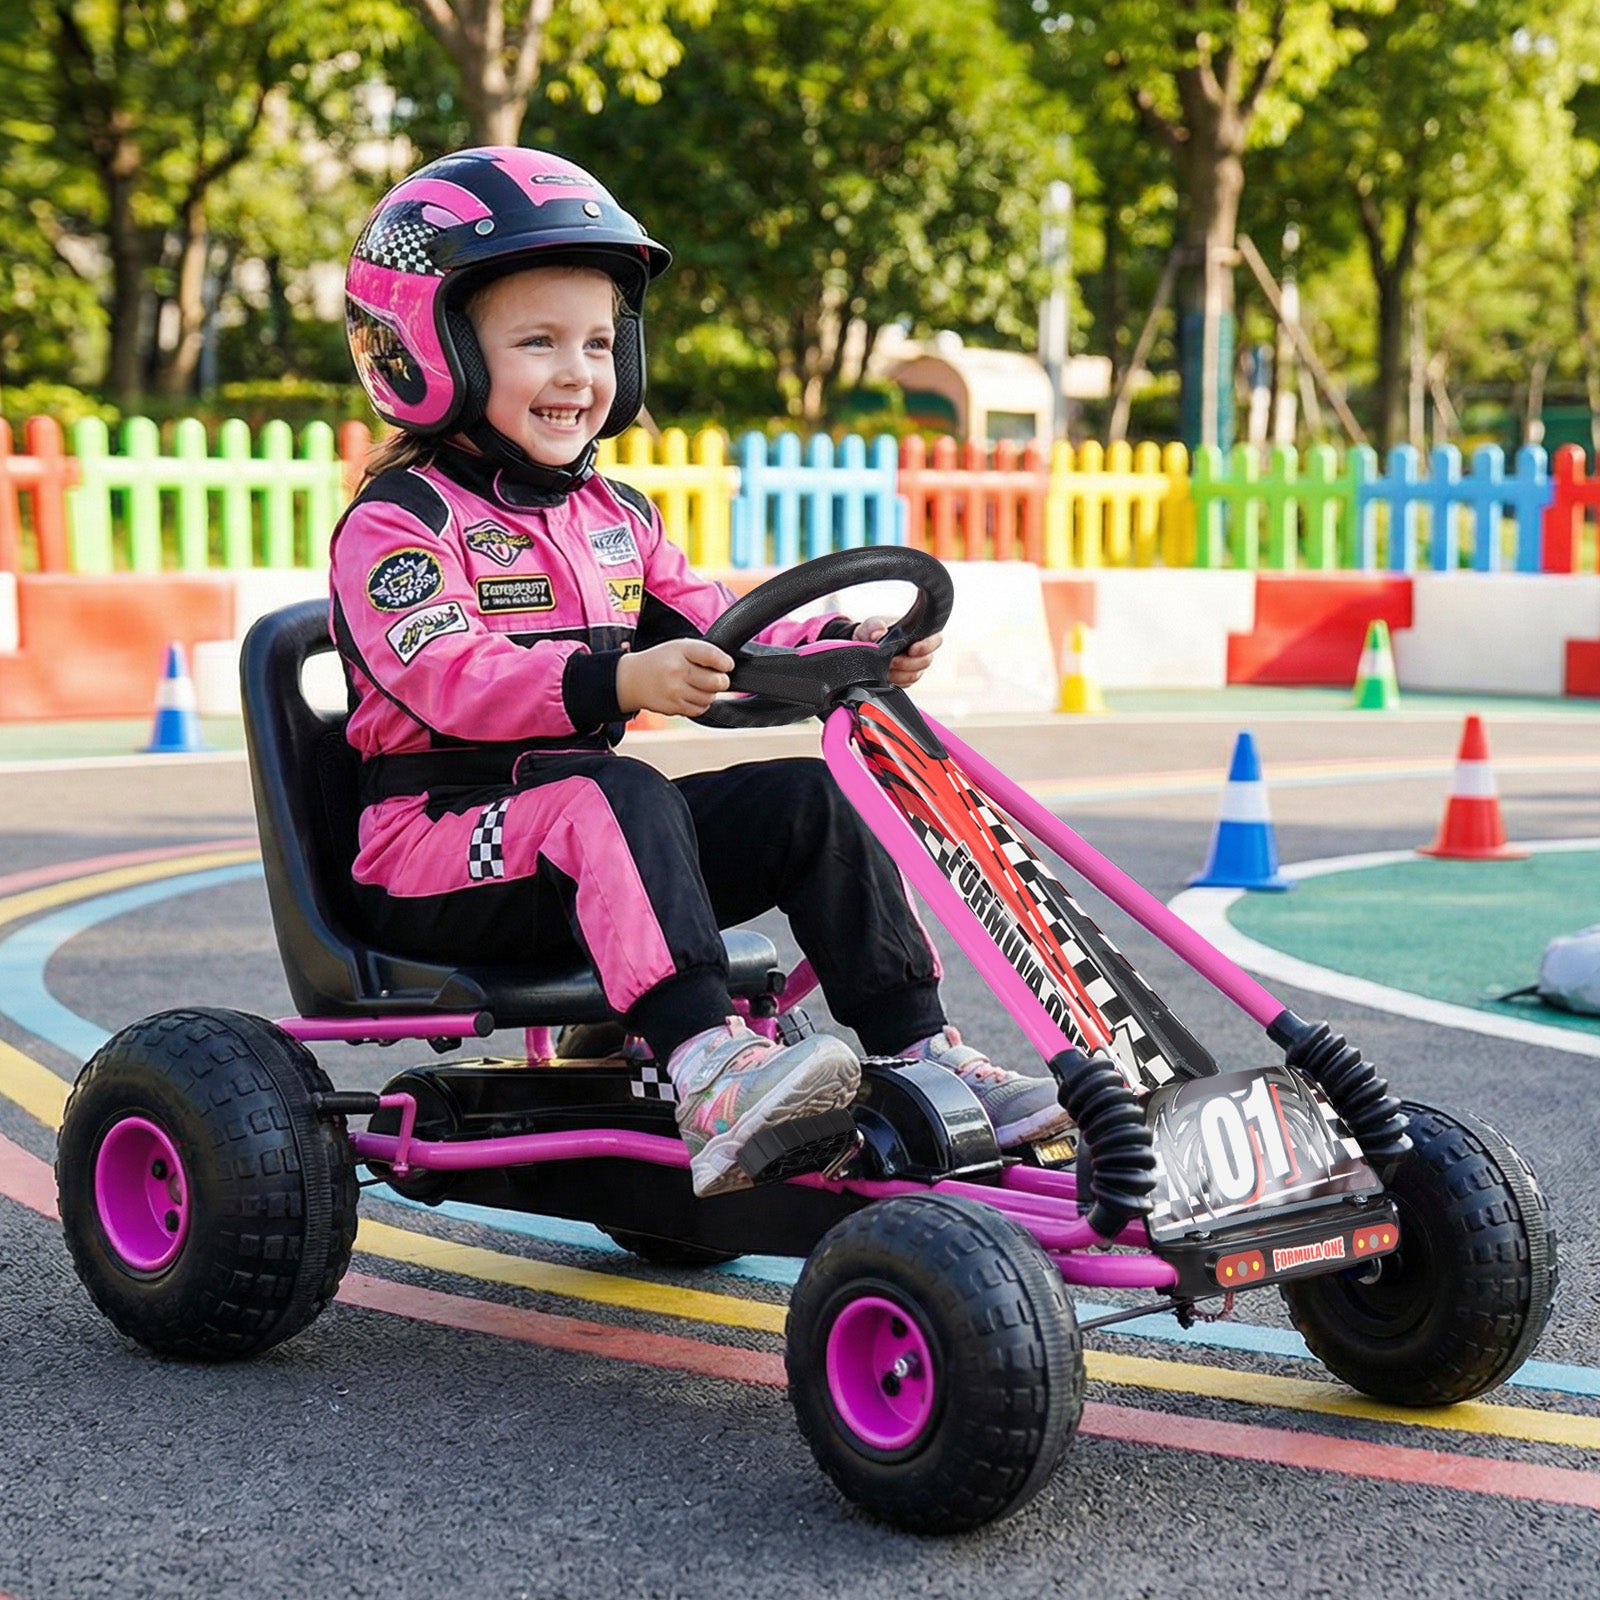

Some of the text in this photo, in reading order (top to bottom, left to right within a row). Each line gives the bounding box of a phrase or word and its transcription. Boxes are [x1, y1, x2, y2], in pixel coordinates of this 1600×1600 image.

[1200, 1077, 1291, 1201] 01
[1273, 1238, 1344, 1271] FORMULA ONE
